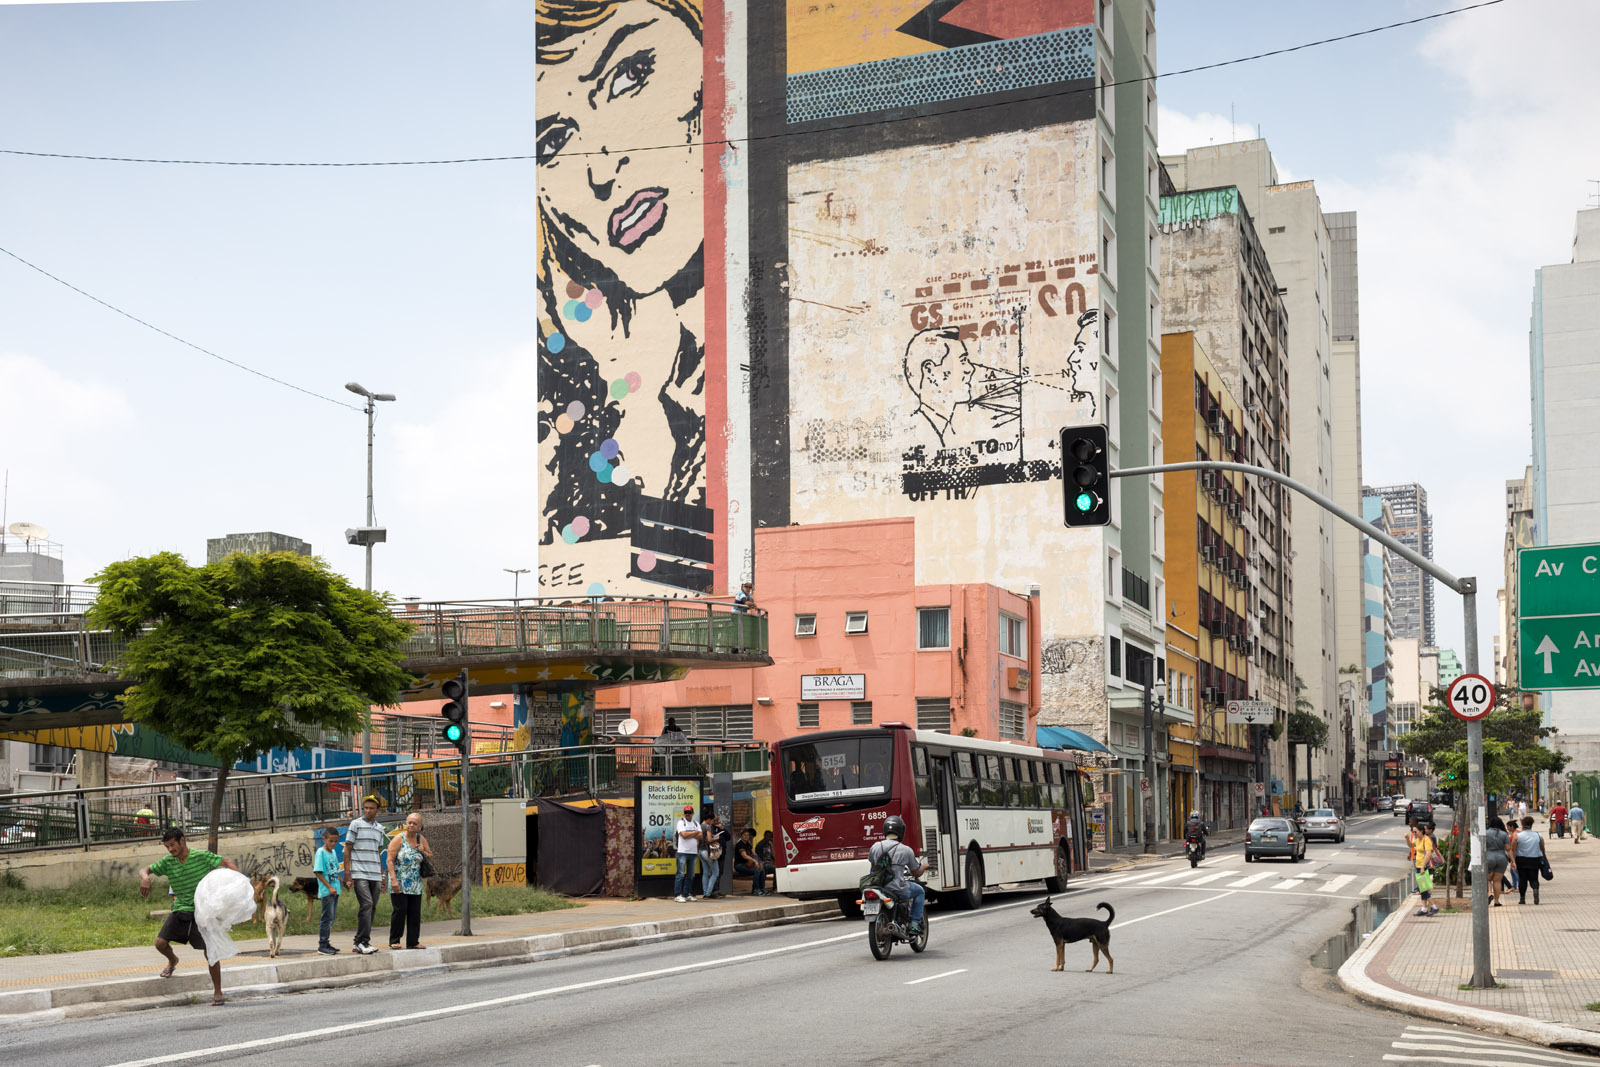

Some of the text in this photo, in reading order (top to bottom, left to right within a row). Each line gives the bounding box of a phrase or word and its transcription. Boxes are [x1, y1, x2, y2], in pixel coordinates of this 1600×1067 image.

[1061, 368, 1070, 378] N
[1535, 559, 1564, 577] Av
[813, 676, 854, 686] BRAGA
[1454, 684, 1487, 705] 40
[824, 756, 845, 767] 5154
[648, 785, 686, 793] Black Friday
[868, 811, 887, 820] 6858
